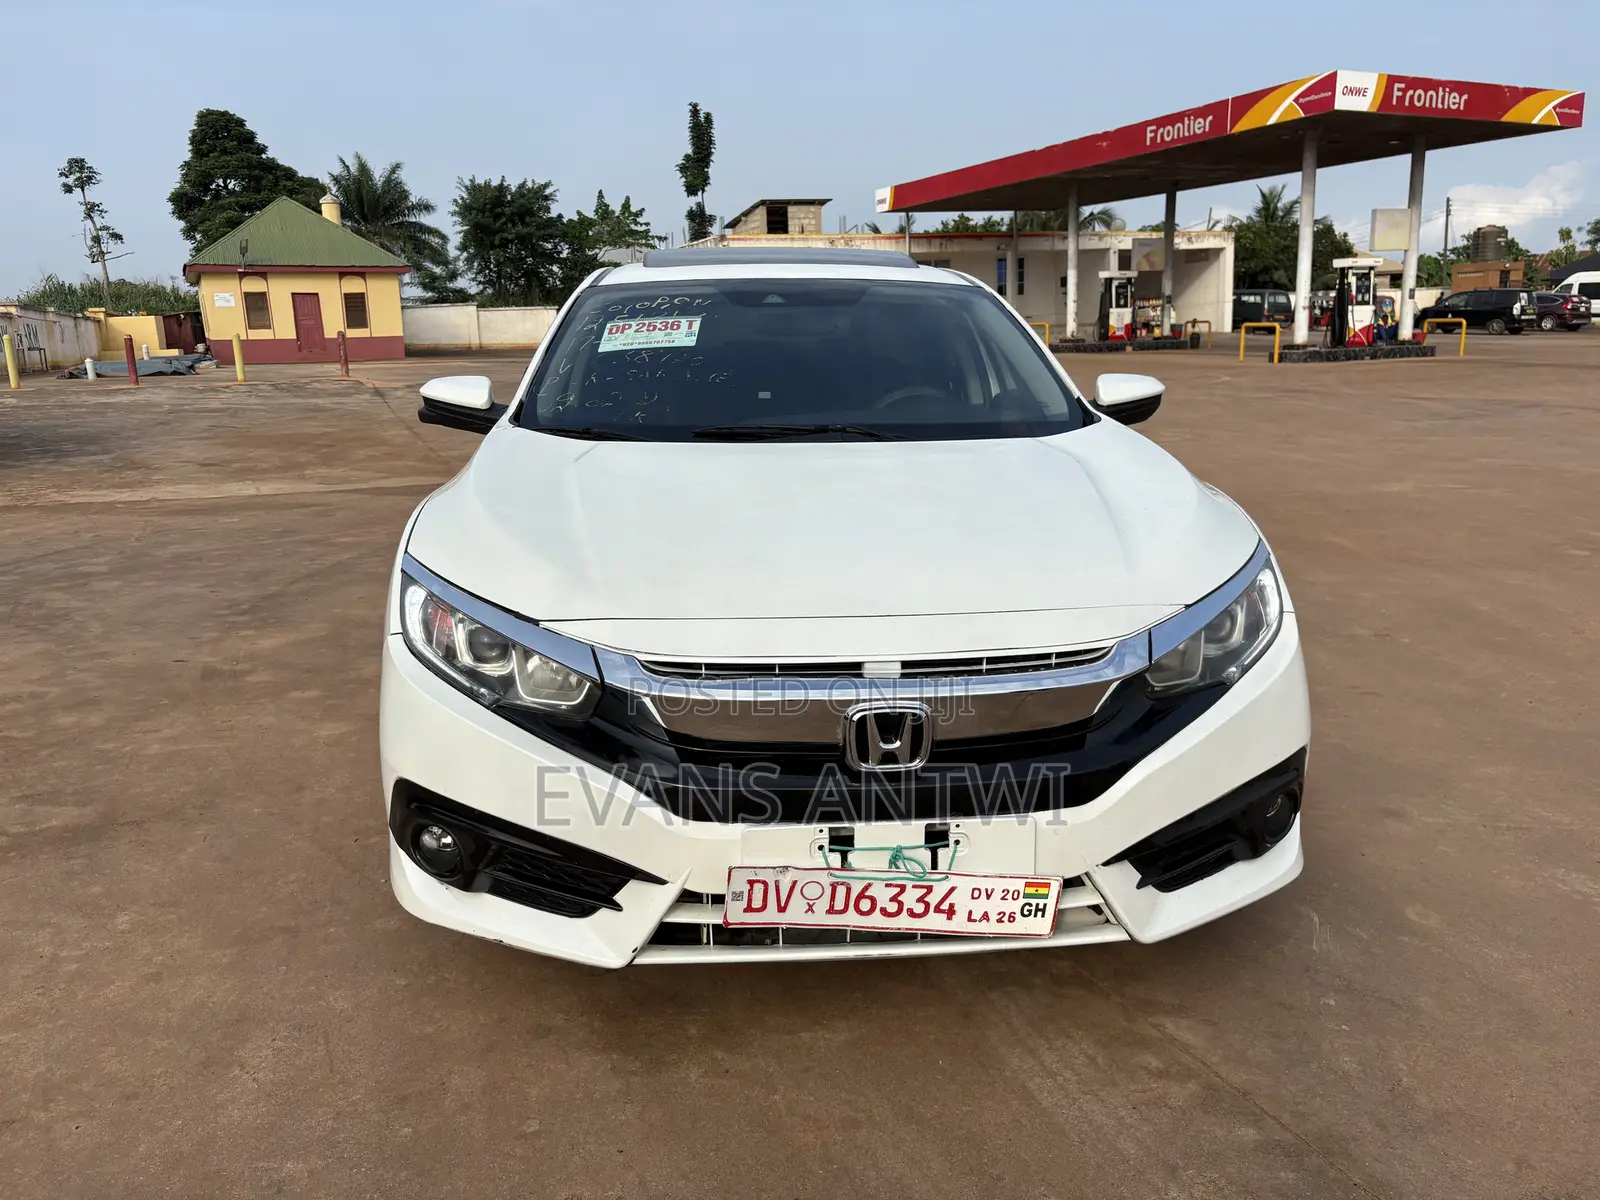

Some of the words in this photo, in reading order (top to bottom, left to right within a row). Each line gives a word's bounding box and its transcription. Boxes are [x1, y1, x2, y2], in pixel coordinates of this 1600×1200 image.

[1342, 85, 1369, 98] ONWE
[1392, 82, 1468, 111] Frontier
[1145, 115, 1213, 146] Frontier
[634, 320, 682, 334] 2536
[686, 319, 698, 331] T
[743, 879, 798, 913] DV
[825, 881, 958, 921] D6334
[970, 887, 996, 901] DV
[1000, 888, 1021, 901] 20
[967, 909, 991, 923] LA
[996, 911, 1017, 924] 26
[1020, 902, 1048, 918] GH
